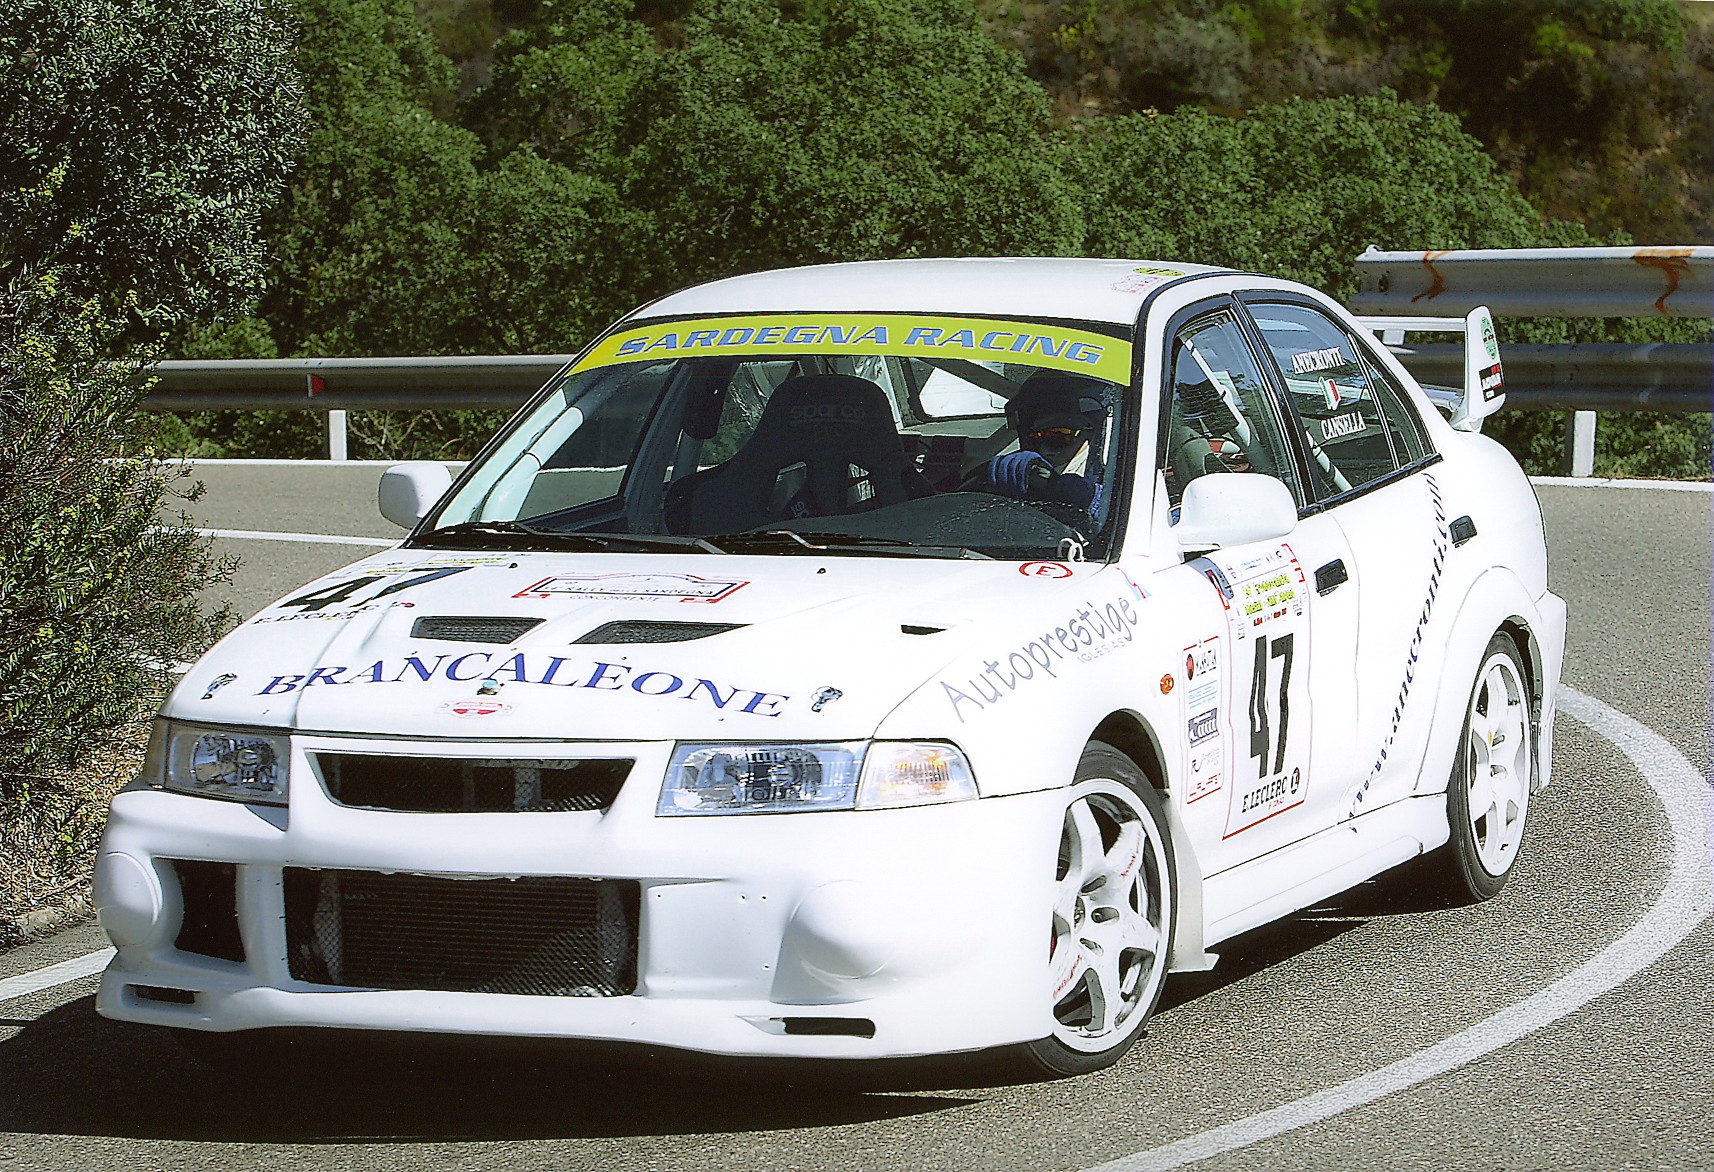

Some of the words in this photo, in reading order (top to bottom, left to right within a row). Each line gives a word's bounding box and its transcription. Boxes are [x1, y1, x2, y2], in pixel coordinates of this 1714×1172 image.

[615, 325, 890, 358] SARDEGNA
[902, 326, 1106, 364] RACING
[789, 404, 866, 421] sparco
[278, 566, 474, 612] 47
[253, 651, 790, 718] BRANCALEONE
[940, 597, 1137, 723] Autoprestige
[1249, 633, 1294, 779] 47
